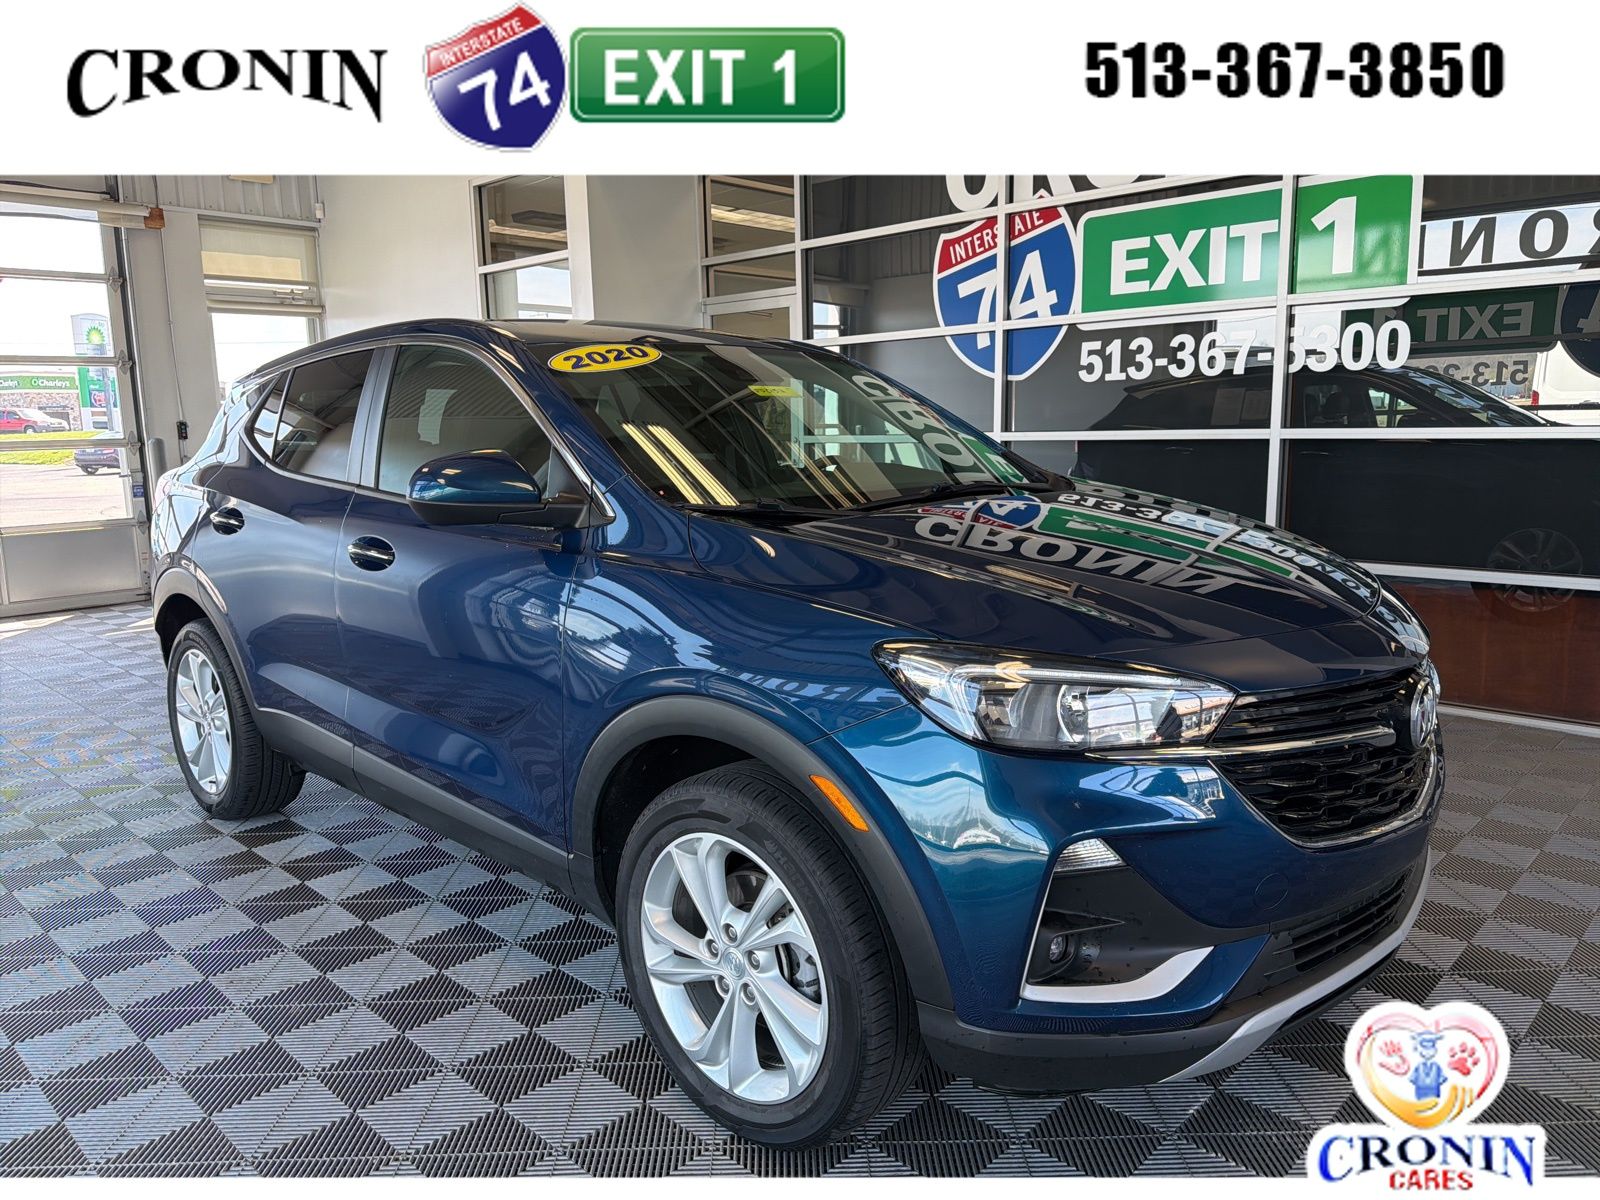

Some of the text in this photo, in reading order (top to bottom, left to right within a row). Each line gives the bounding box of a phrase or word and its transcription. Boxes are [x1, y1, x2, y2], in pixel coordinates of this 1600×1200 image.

[949, 211, 1044, 264] INTERATE
[1110, 196, 1357, 295] EXIT 1
[957, 249, 1058, 350] 74
[563, 345, 647, 369] 2020
